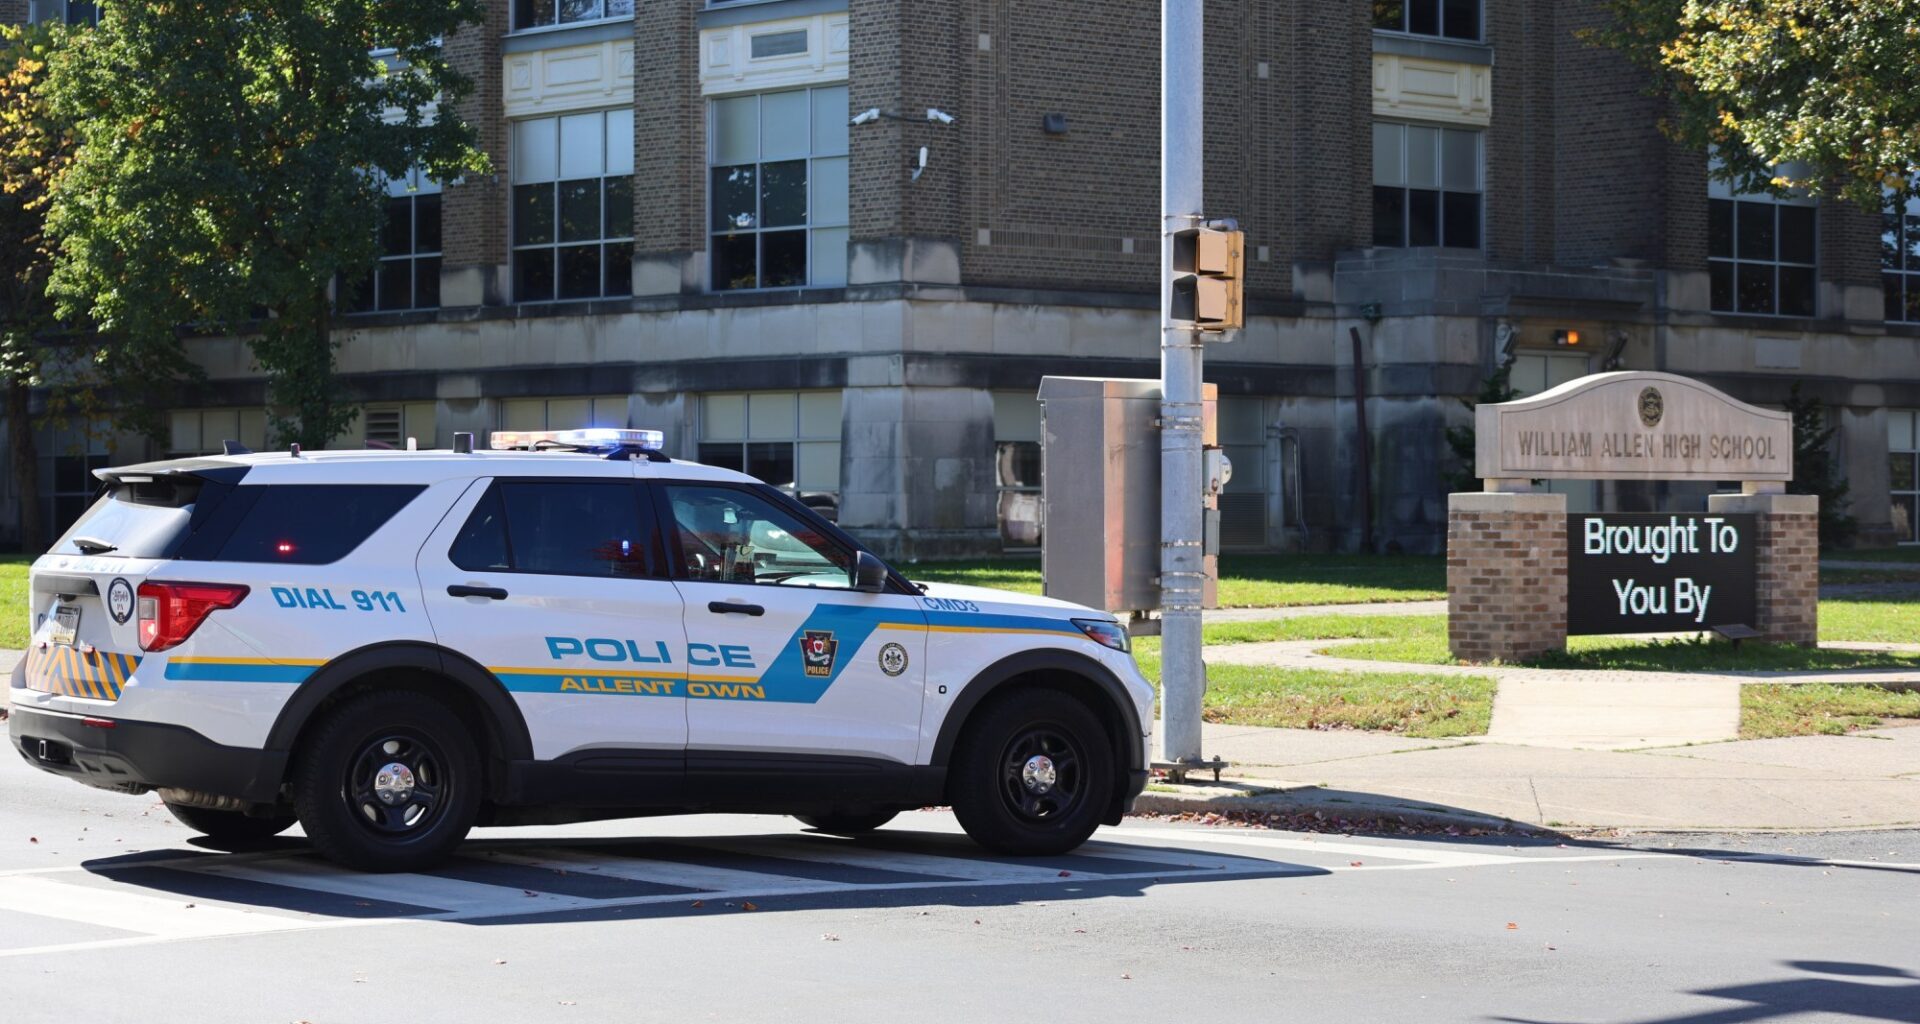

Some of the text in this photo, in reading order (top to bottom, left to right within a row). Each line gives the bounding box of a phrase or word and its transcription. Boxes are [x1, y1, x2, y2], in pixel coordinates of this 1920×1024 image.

[1518, 431, 1776, 460] WILLIAM ALLEN HIGH SCHOOL
[1584, 516, 1738, 563] Brought To
[270, 586, 406, 613] DIAL 911
[923, 597, 979, 612] CMD3
[1612, 578, 1711, 622] You By
[807, 665, 829, 675] POLICE
